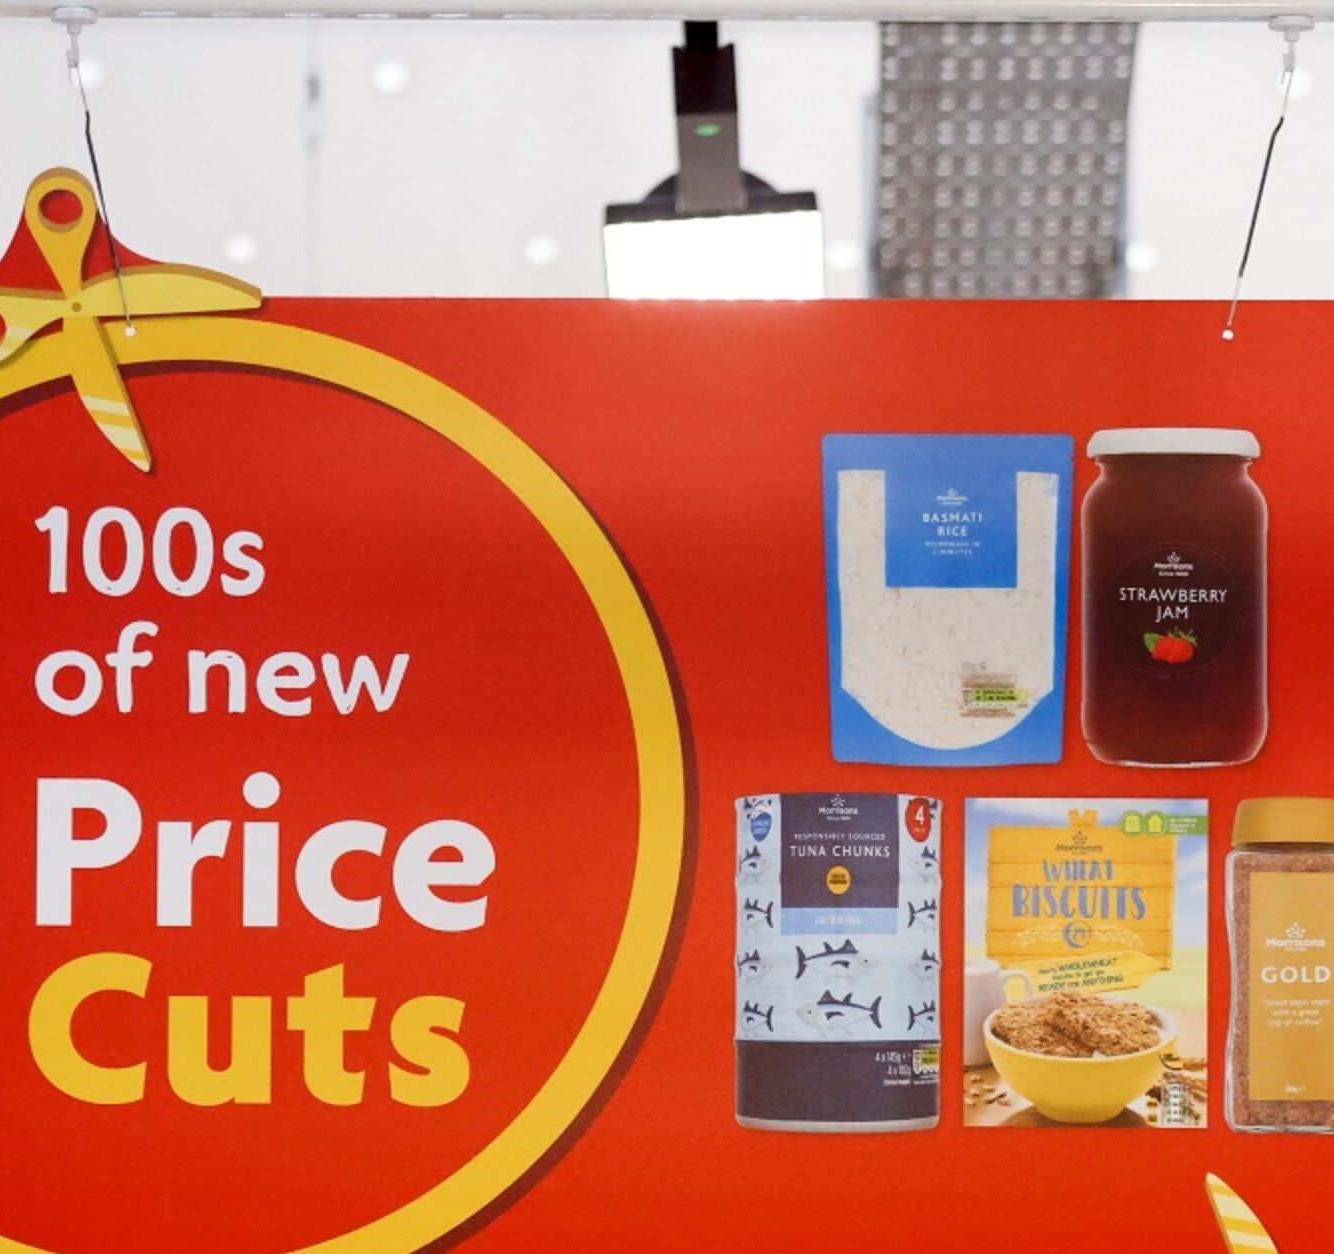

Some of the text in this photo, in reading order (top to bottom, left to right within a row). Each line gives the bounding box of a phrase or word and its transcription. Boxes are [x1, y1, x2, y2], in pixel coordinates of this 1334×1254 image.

[922, 511, 983, 523] BASMATI
[937, 525, 968, 537] RICE
[34, 505, 266, 598] 100s
[1118, 587, 1228, 603] STRAWBERRY
[1155, 605, 1188, 623] JAM
[34, 621, 410, 716] of new
[915, 805, 925, 826] 4
[35, 771, 496, 933] Price
[789, 845, 891, 857] TUNA CHUNKS
[1043, 859, 1113, 881] WHEAT
[1012, 884, 1146, 920] BISCUITS
[1260, 965, 1332, 983] GOLD
[28, 951, 471, 1107] Cuts
